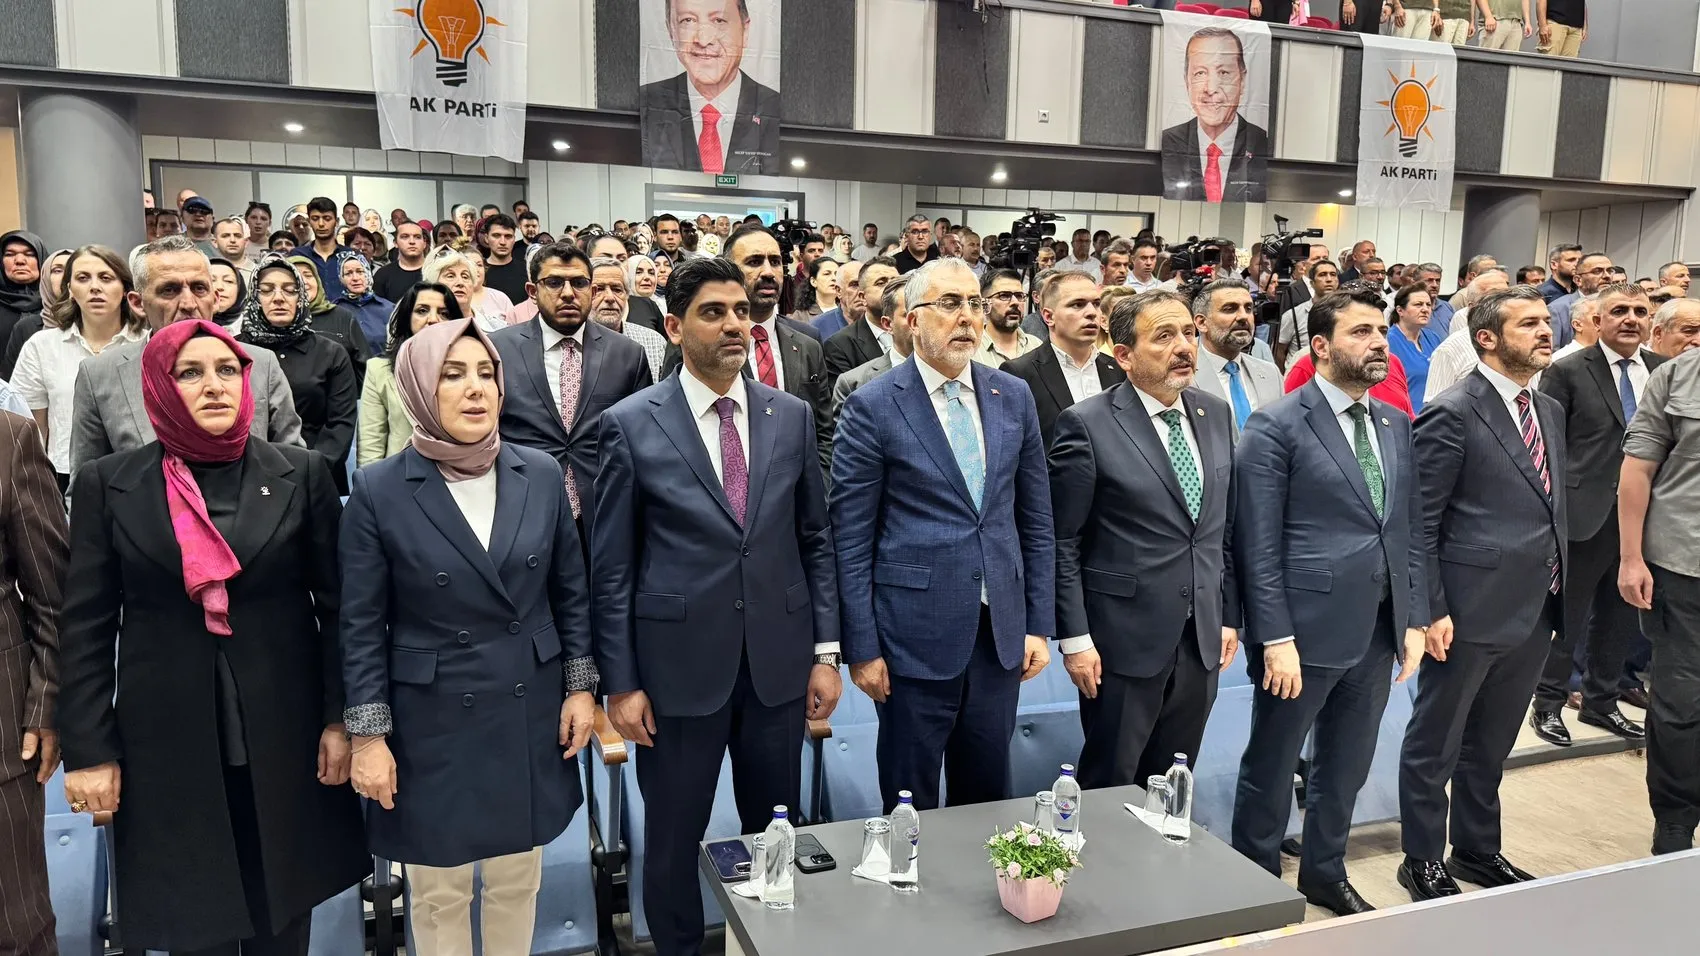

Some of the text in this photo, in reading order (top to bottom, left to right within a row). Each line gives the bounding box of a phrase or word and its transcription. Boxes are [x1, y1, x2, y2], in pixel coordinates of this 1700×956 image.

[410, 96, 437, 113] AK
[1380, 165, 1399, 178] AK
[718, 176, 736, 184] EXIT
